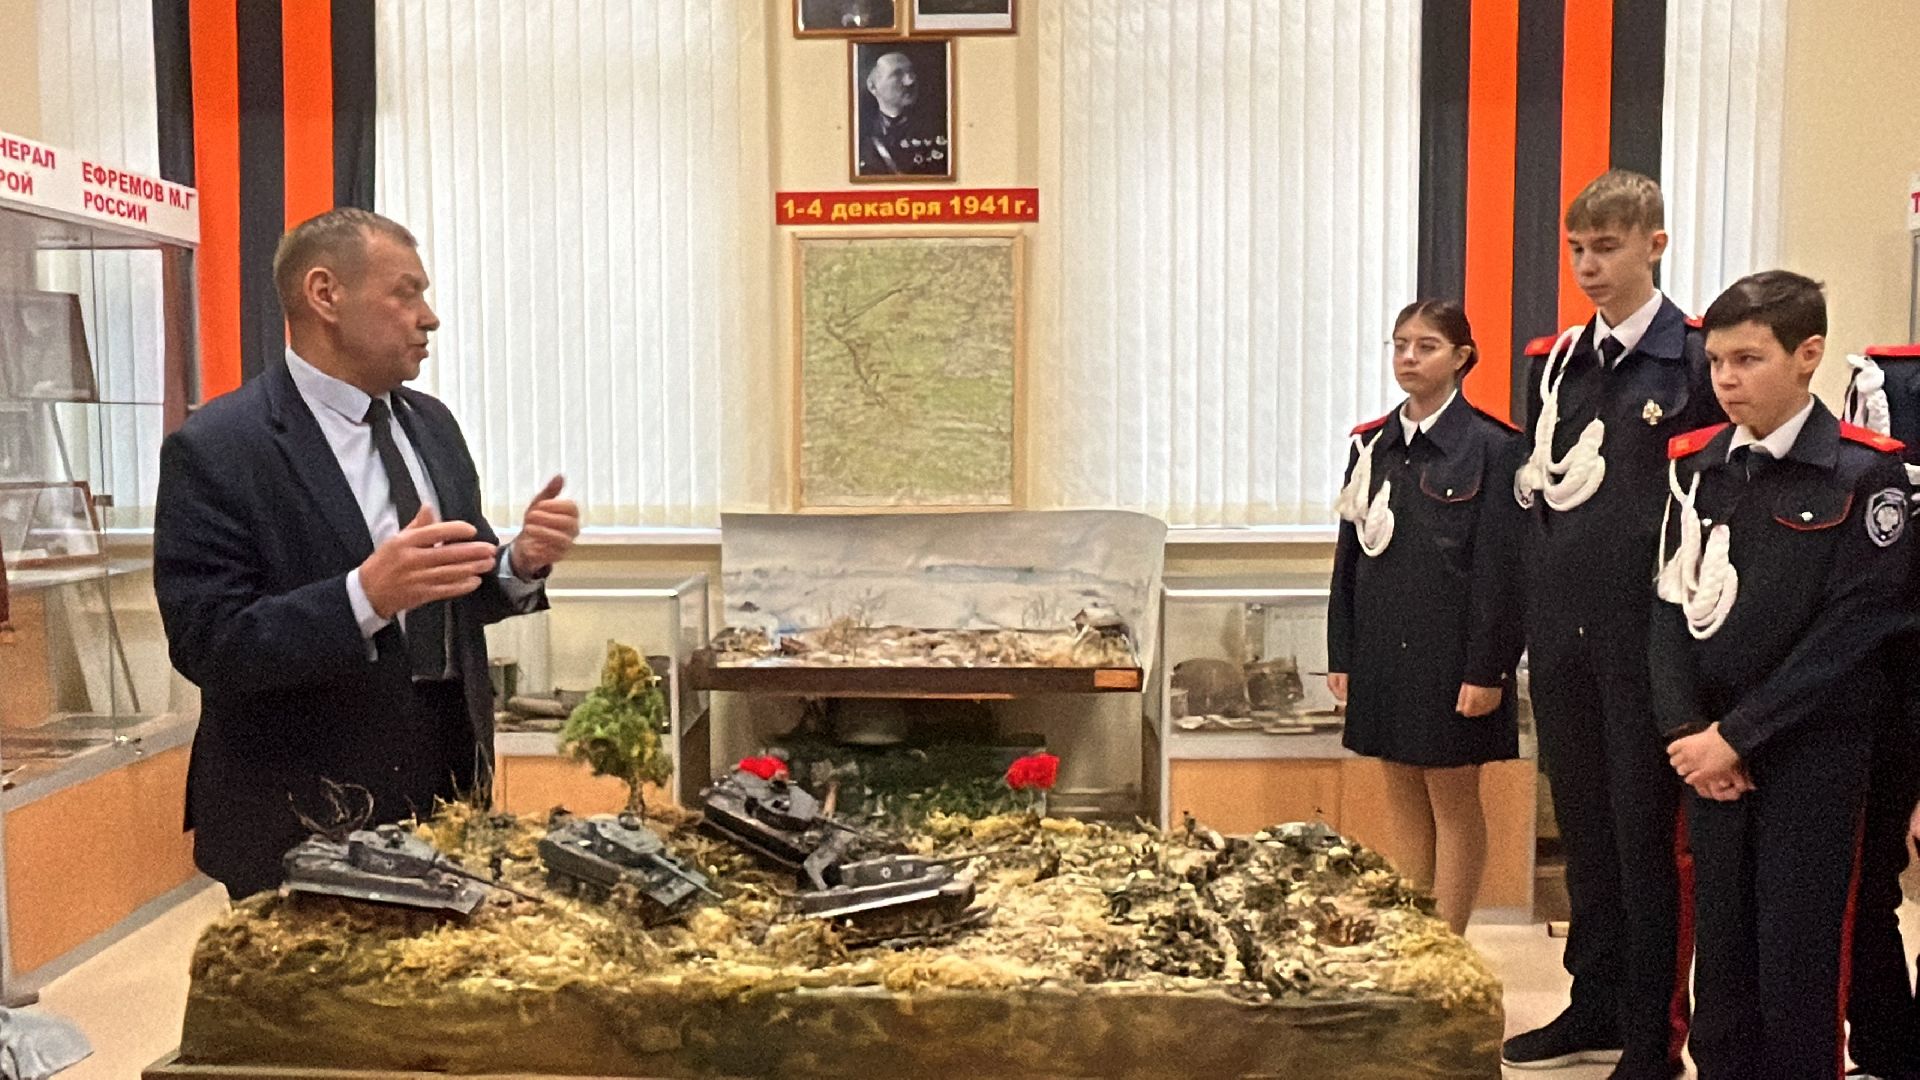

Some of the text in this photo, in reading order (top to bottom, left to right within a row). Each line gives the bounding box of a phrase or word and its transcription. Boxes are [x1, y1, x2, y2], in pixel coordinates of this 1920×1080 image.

[82, 161, 164, 202] ЕФРЕМОВ
[84, 190, 147, 223] РОССИИ
[783, 195, 1034, 221] 1-4 декабря 1941г.
